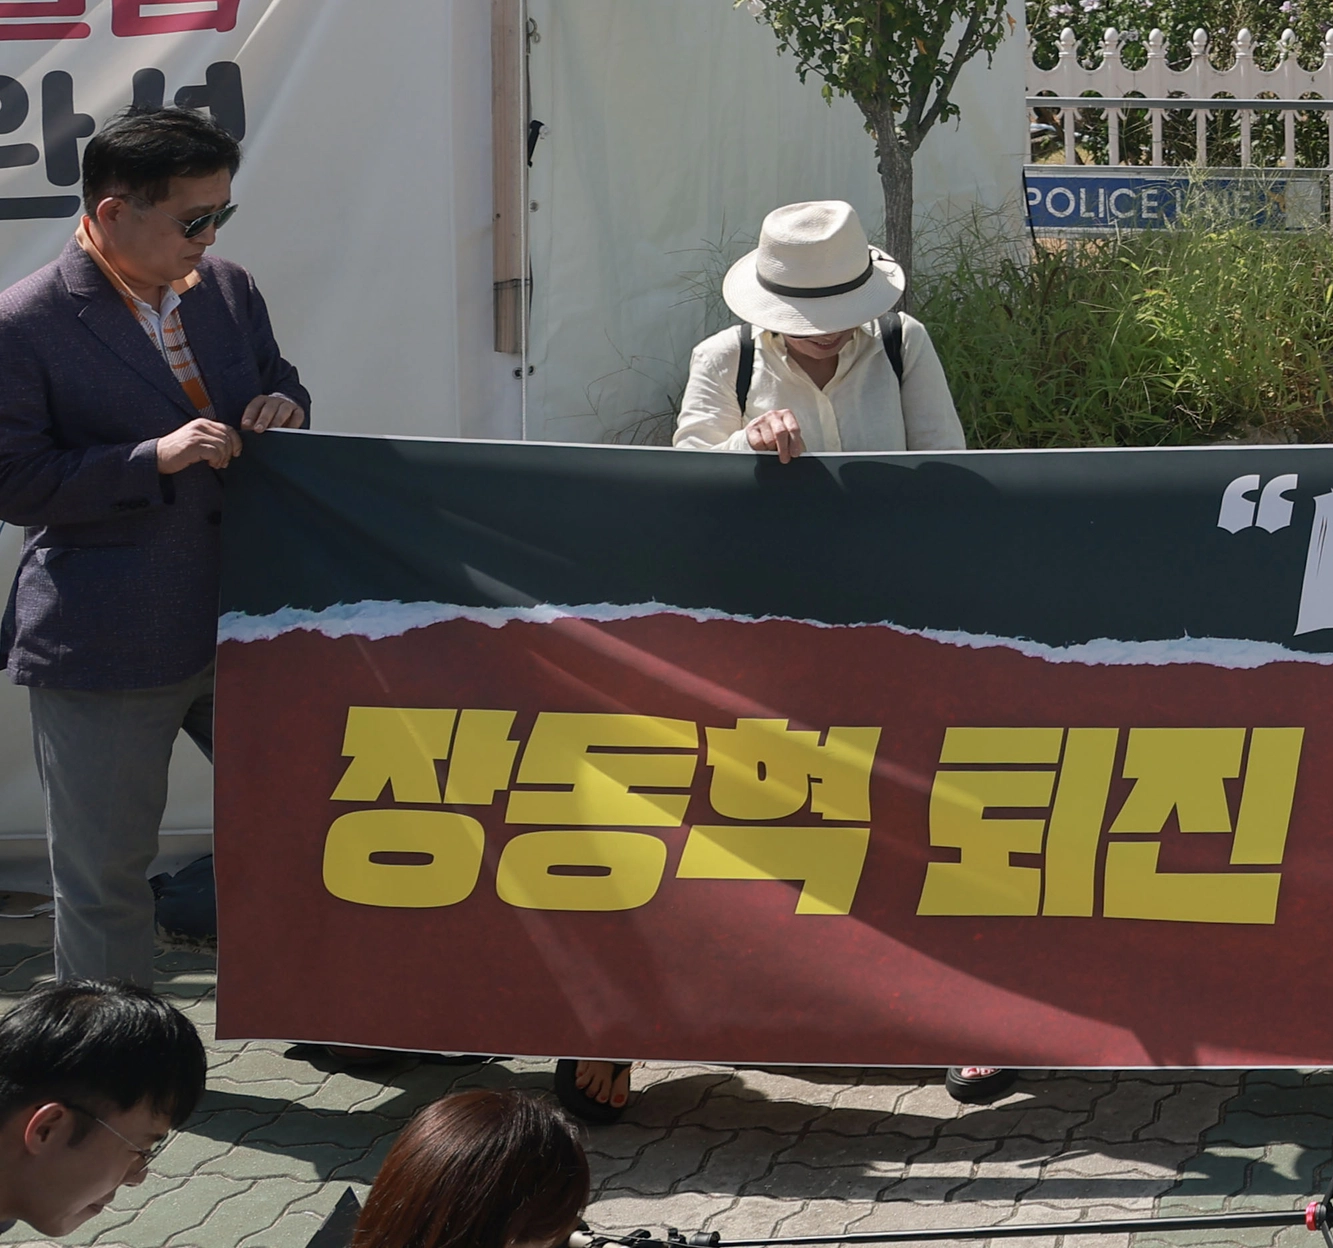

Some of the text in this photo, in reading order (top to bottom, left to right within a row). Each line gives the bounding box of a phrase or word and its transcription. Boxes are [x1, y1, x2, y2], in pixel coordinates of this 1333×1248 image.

[1025, 187, 1159, 218] POLICE
[323, 706, 881, 915] 장동혁
[917, 727, 1305, 925] 퇴진
